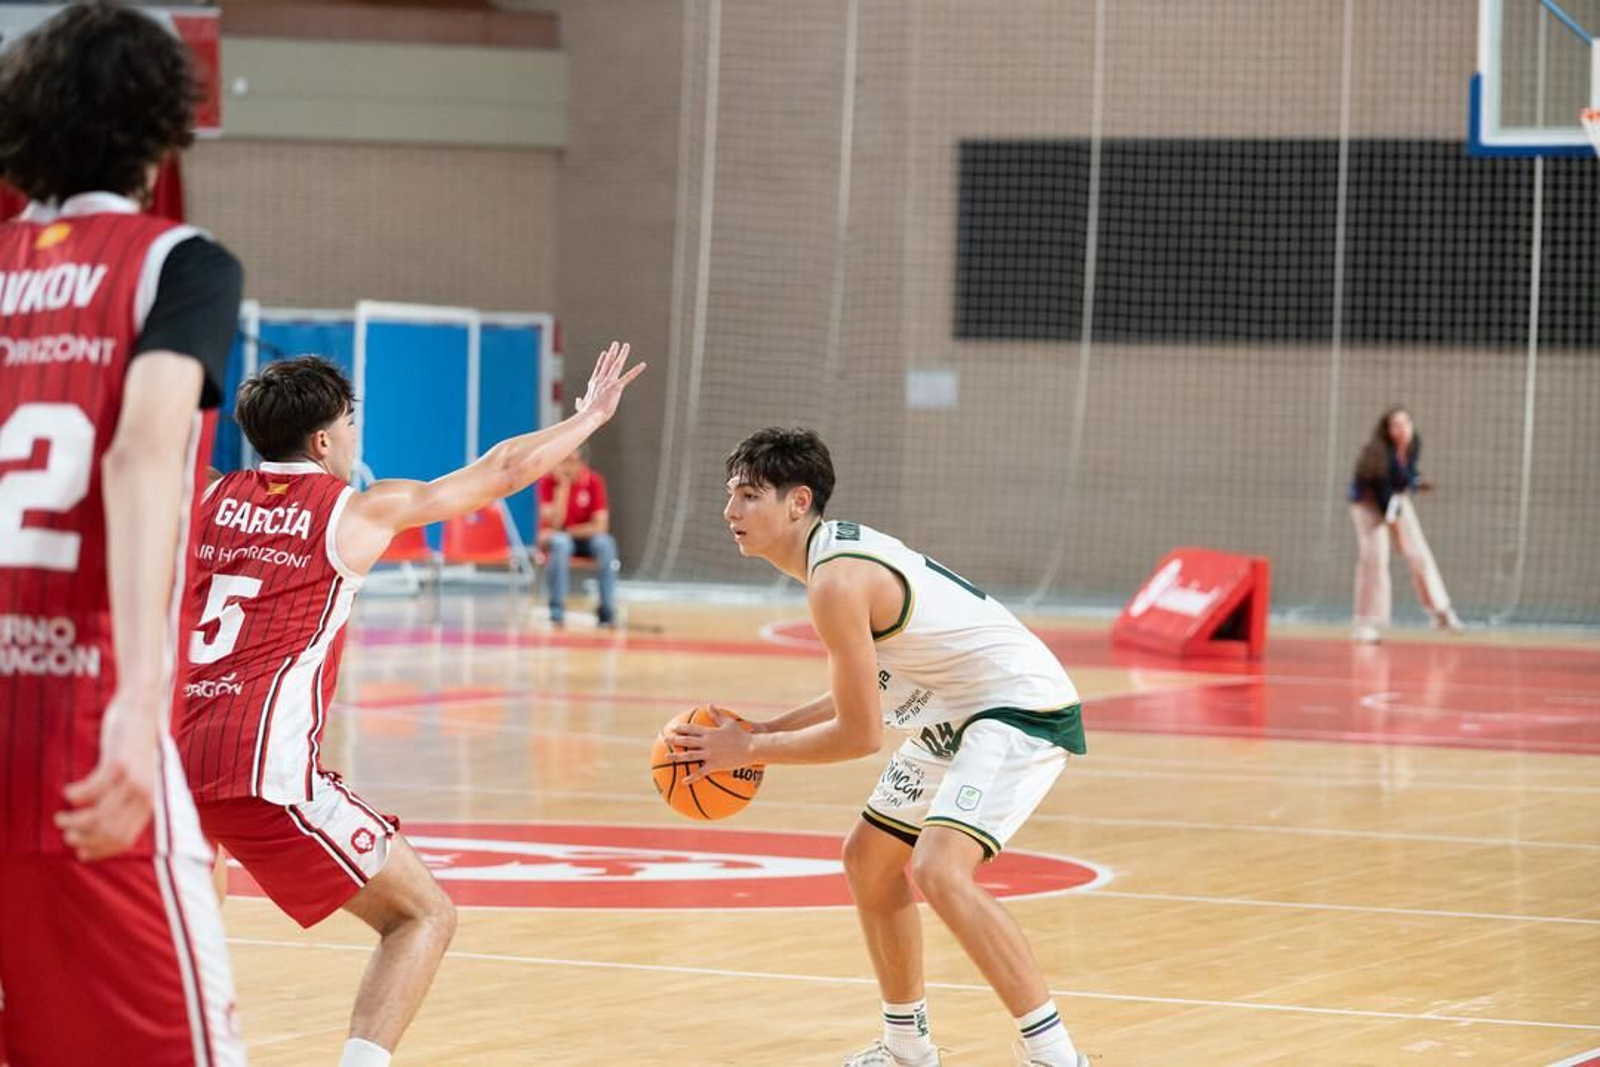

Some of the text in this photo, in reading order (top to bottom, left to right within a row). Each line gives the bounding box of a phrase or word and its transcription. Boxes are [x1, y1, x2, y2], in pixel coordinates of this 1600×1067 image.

[0, 402, 96, 572] 2
[215, 498, 312, 540] GARCÍA
[188, 574, 262, 664] 5
